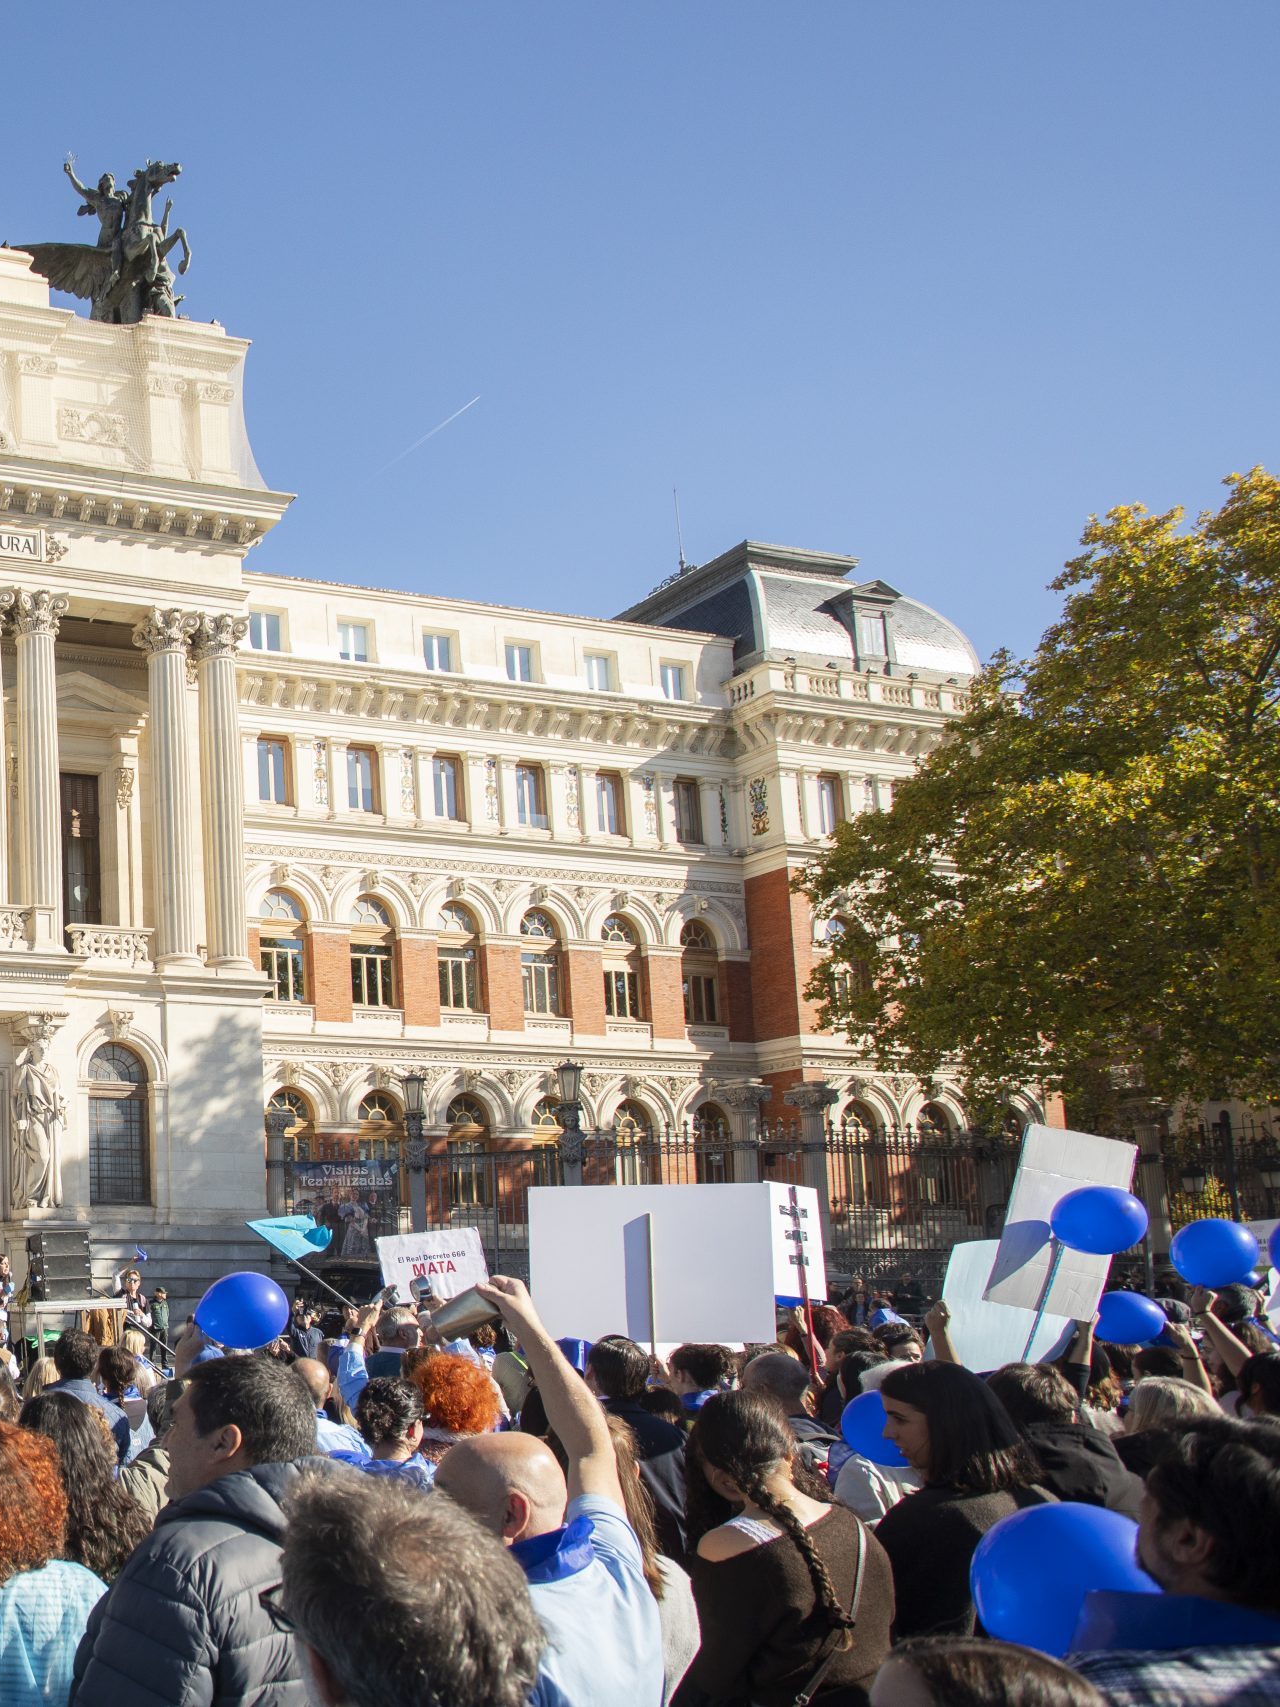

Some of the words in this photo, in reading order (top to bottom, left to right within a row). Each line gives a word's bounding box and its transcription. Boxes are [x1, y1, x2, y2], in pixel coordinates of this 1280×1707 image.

[321, 1164, 368, 1175] Visitas
[300, 1175, 393, 1187] Teatralizadas
[406, 1255, 421, 1263] Real
[412, 1260, 457, 1277] MATA
